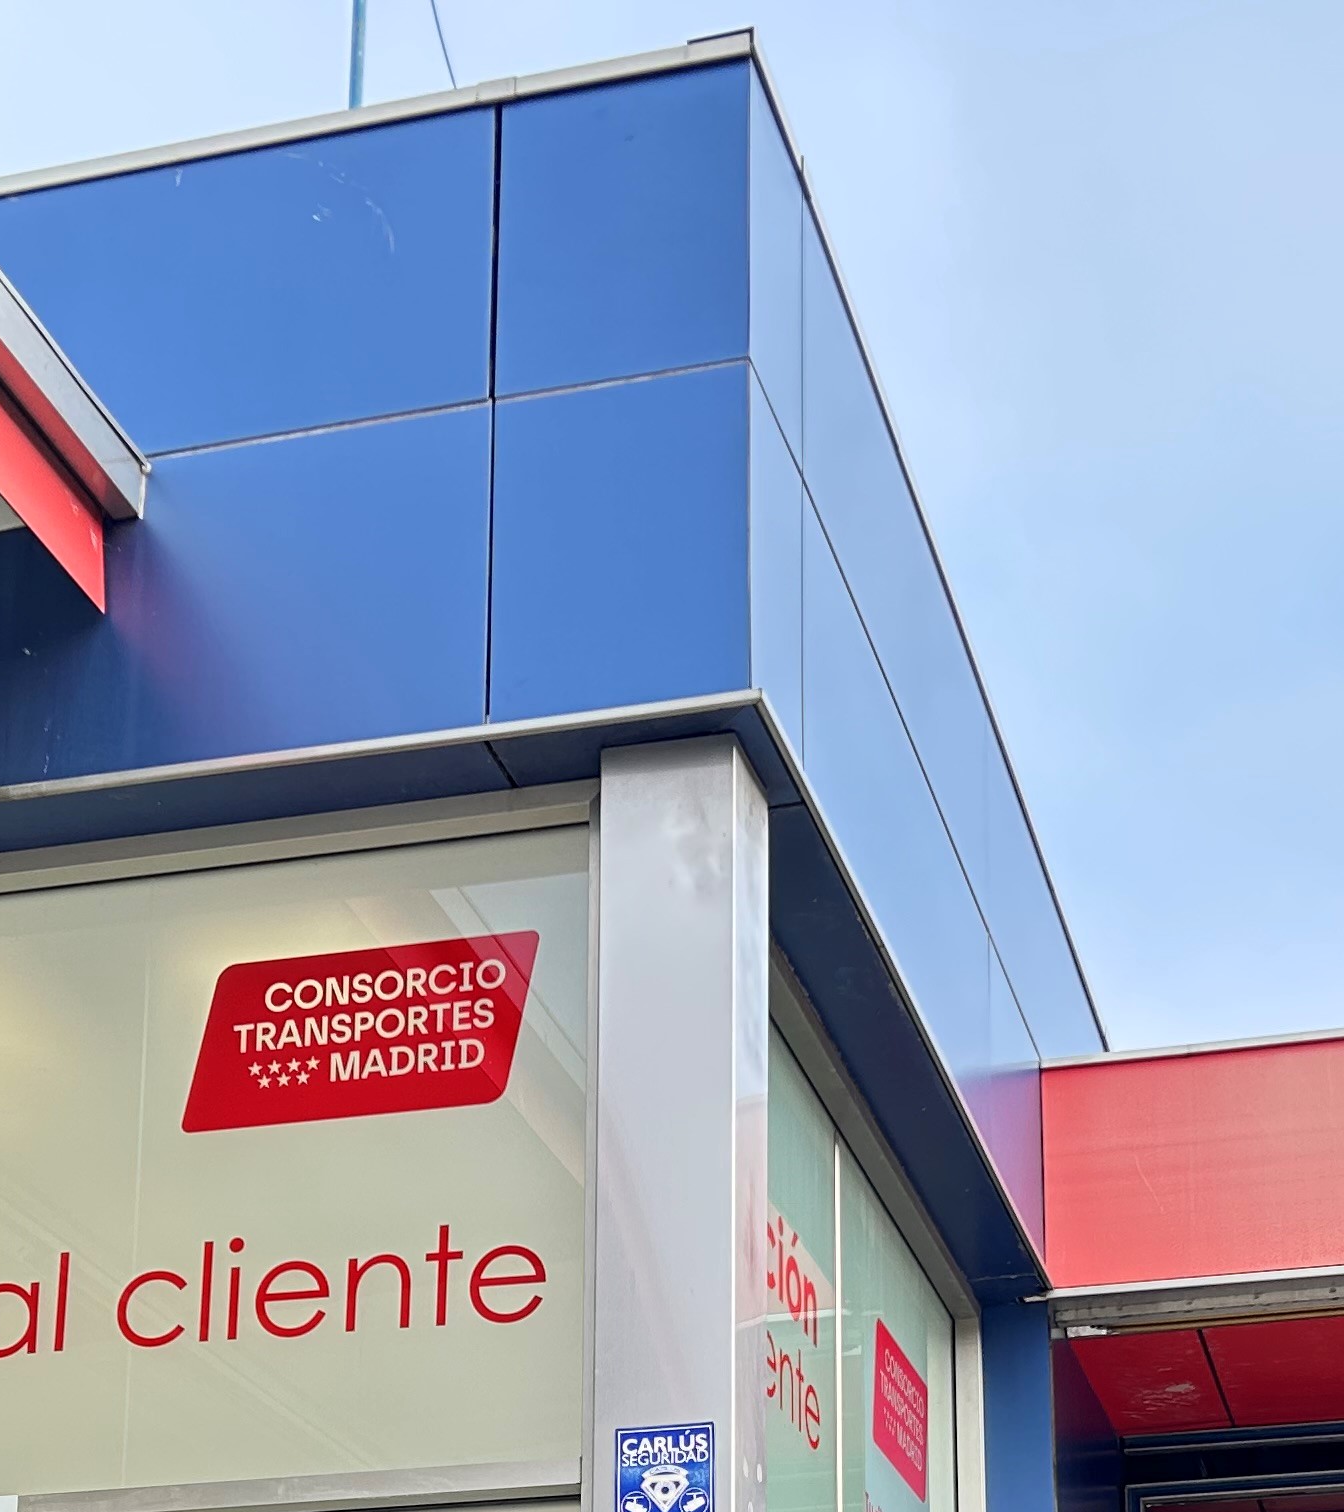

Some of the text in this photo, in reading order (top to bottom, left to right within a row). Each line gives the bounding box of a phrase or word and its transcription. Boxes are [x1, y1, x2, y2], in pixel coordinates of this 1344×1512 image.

[264, 958, 506, 1013] CONSORCIO
[233, 998, 495, 1053] TRANSPORTES
[329, 1038, 485, 1082] MADRID
[117, 1224, 547, 1348] cliente
[879, 1368, 924, 1446] TRANSPORTES
[884, 1348, 925, 1418] CONSORCIO
[621, 1449, 709, 1467] SEGURIDAD
[622, 1429, 708, 1455] CARLÚS
[896, 1422, 922, 1472] MADRID
